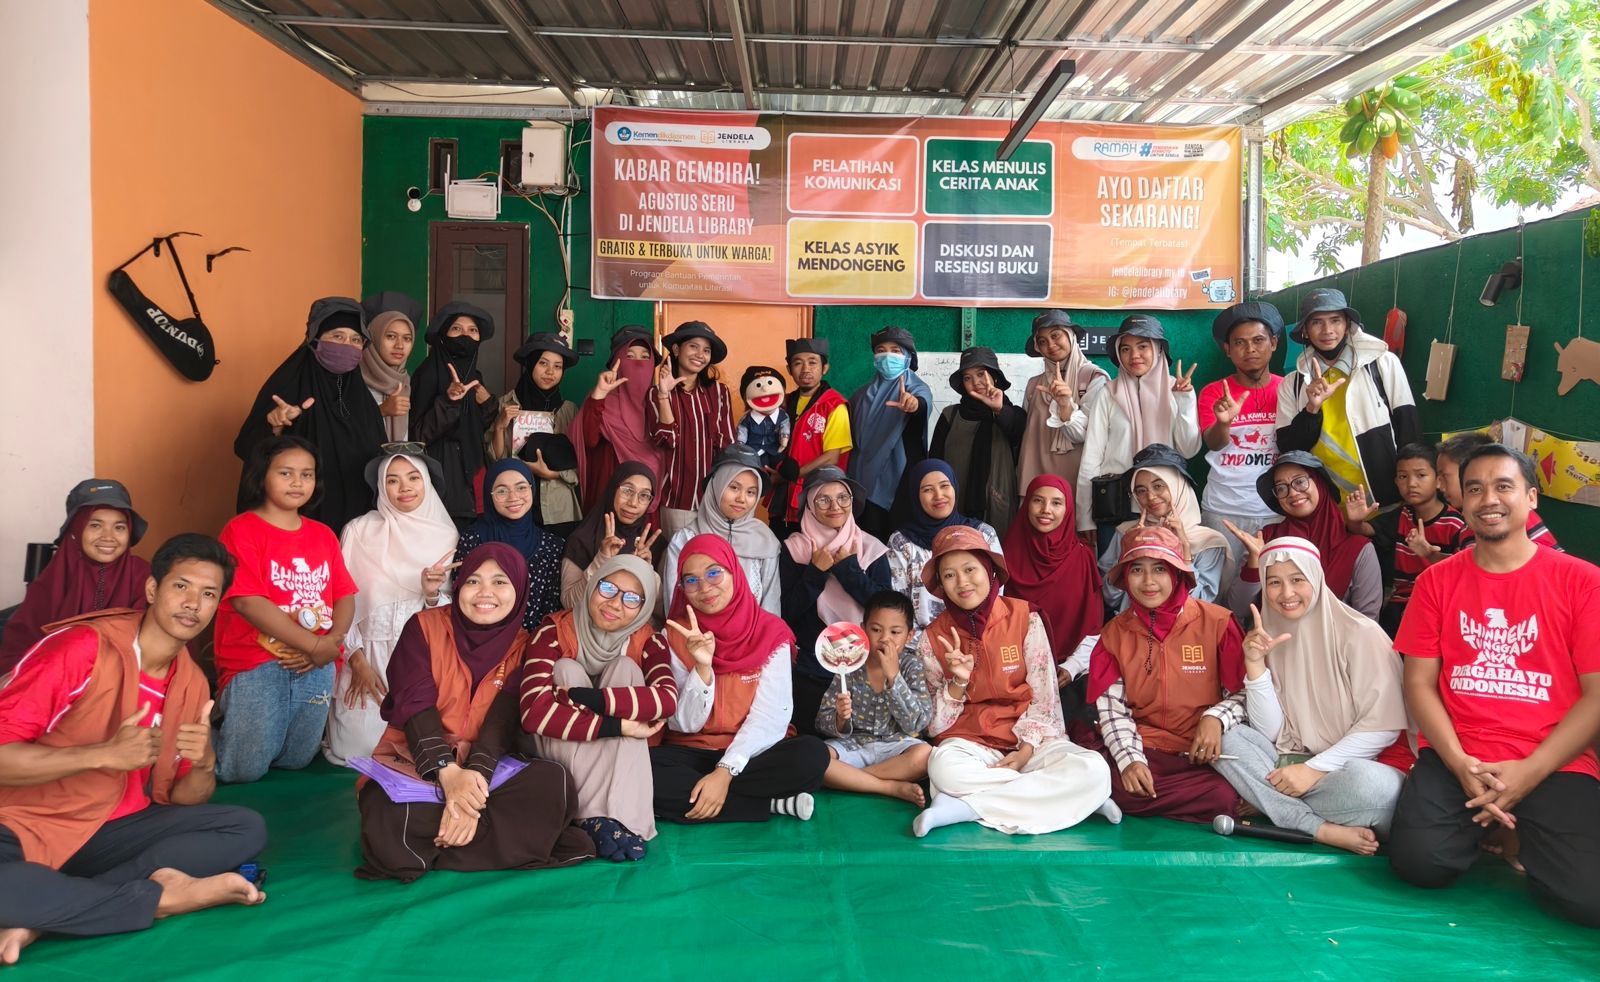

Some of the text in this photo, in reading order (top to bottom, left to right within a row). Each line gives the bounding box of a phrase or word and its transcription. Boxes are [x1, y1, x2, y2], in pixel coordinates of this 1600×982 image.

[717, 132, 754, 141] JENDELA
[1094, 142, 1137, 157] RAMAH
[614, 158, 760, 185] KABAR GEMBIRA!
[813, 159, 894, 174] PELATIHAN
[932, 159, 1046, 175] KELAS MENULIS
[804, 175, 901, 192] KOMUNIKASI
[939, 176, 1039, 191] CERITA ANAK
[1097, 175, 1204, 201] AYO DAFTAR
[638, 192, 735, 213] AGUSTUS SERU
[1100, 203, 1200, 230] SEKARANG!
[619, 213, 754, 236] DI JENDELA LIBRARY
[599, 240, 772, 261] GRATIS & TERBUKA UNTUK WARGA!
[804, 241, 900, 256] KELAS ASYIK
[940, 244, 1034, 258] DISKUSI DAN
[797, 257, 905, 272] MENDONGENG
[934, 261, 1038, 275] RESENSI BUKU
[630, 269, 742, 281] Program Bantuan Pemerintah
[638, 281, 733, 292] untuk Komunitas Literasi
[1108, 286, 1188, 299] IG: @jendelalibrary
[146, 307, 199, 349] DUNLOP
[1221, 452, 1279, 467] INDONES
[271, 559, 331, 584] BHINNEKA
[273, 579, 327, 594] TUNGGAL
[1459, 609, 1539, 645] BHINNEKA
[1462, 635, 1535, 657] TUNGGAL
[1485, 649, 1508, 664] IKA
[1449, 677, 1551, 702] INDONESIA
